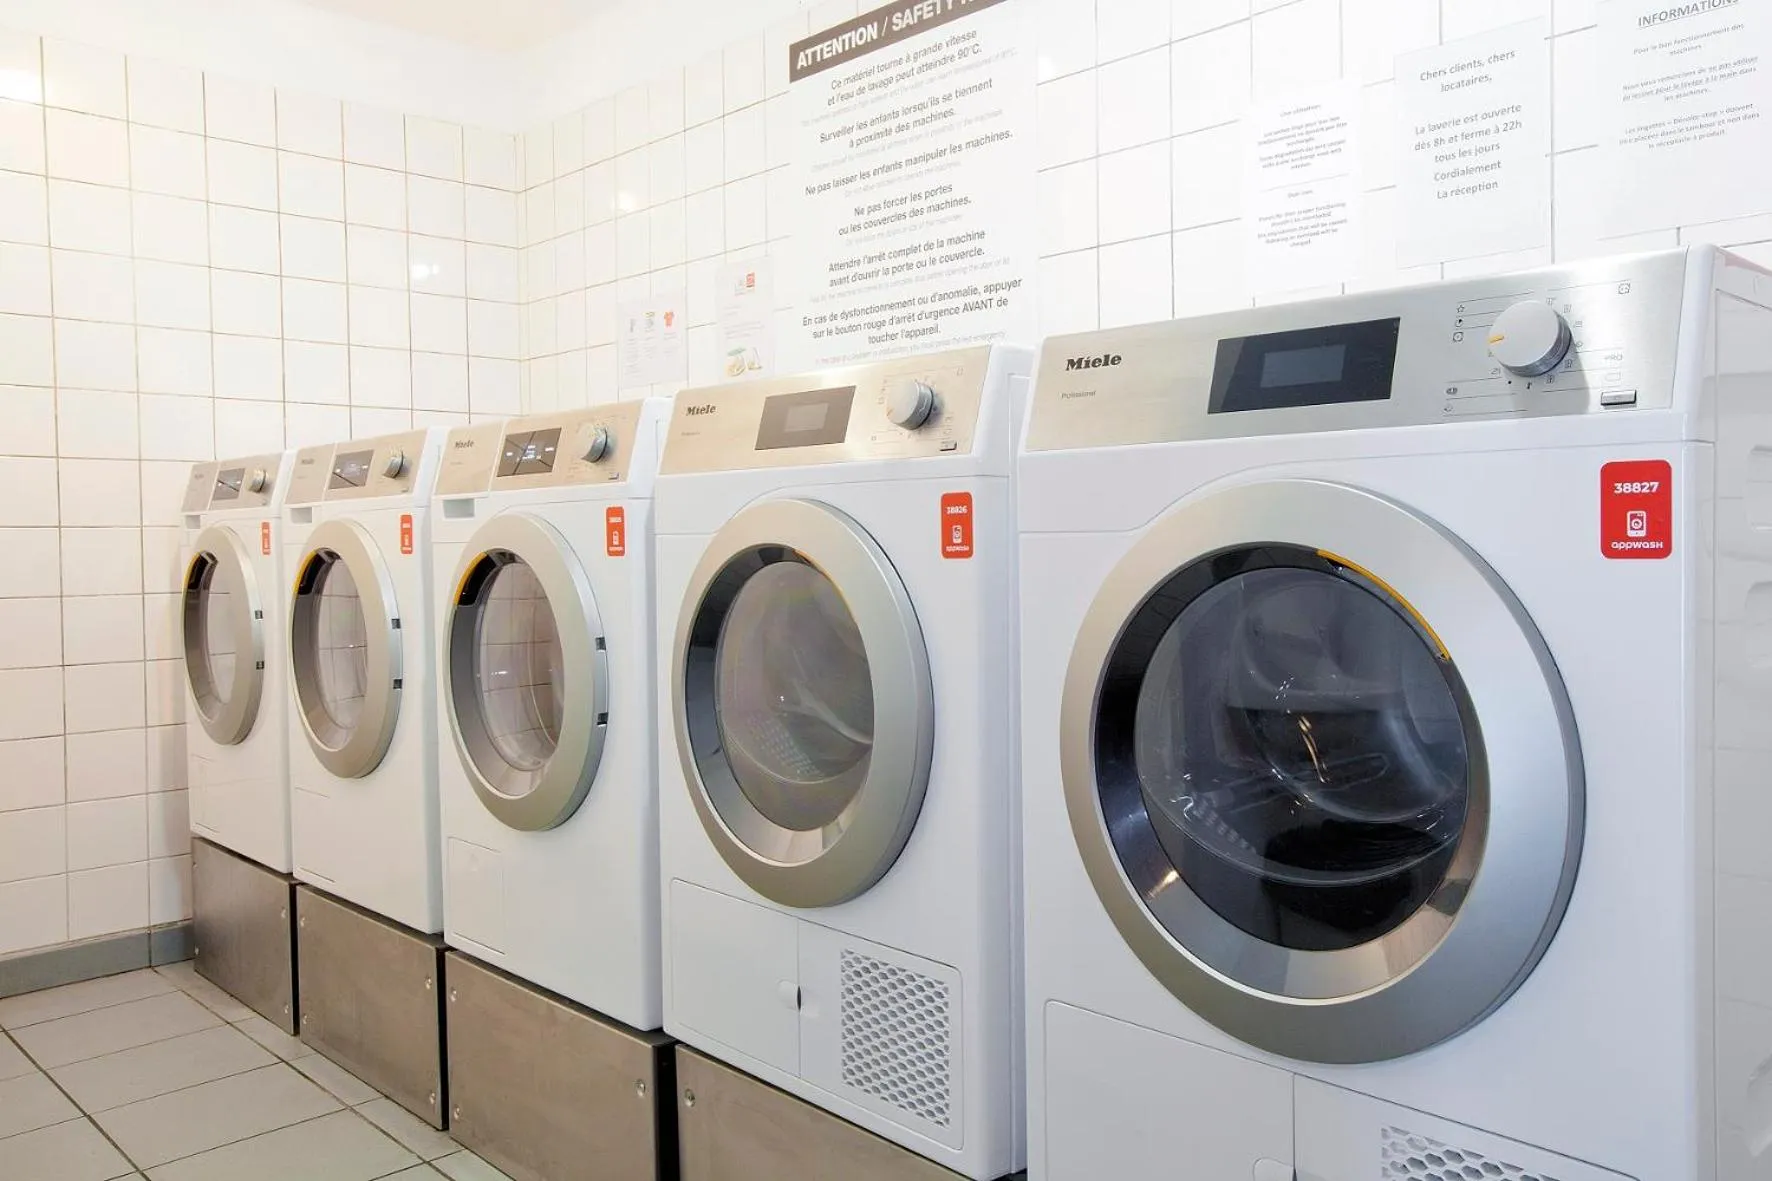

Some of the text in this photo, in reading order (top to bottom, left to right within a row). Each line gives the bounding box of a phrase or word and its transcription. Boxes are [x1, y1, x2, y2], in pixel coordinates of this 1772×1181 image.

[1638, 0, 1739, 28] INFORMATION
[796, 0, 957, 71] ATTENTION / SAFETY
[1420, 51, 1515, 80] Chers clients, chers
[1440, 74, 1492, 92] locataires,
[819, 125, 854, 143] Surveiller
[856, 121, 868, 130] les
[870, 110, 900, 126] enfants
[901, 96, 940, 116] lorsqu'ils
[941, 93, 952, 103] se
[954, 78, 993, 98] tiennent
[1415, 105, 1522, 136] La laverie est ouverte
[1414, 120, 1522, 150] dès 8h et ferme à 22h
[805, 187, 815, 195] Ne
[817, 183, 831, 194] pas
[832, 175, 858, 187] laisser
[860, 171, 871, 180] les
[872, 161, 902, 176] enfants
[904, 148, 948, 166] manipuler
[949, 144, 962, 154] les
[965, 131, 1013, 149] machines.
[1434, 143, 1500, 162] tous les jours
[1433, 160, 1501, 181] Cordialement
[854, 185, 953, 216] Ne pas forcer les portes
[1437, 181, 1498, 199] La réception
[838, 197, 972, 235] ou les couvercles des machines.
[828, 231, 986, 272] Attendre l'arrêt complet de la machine
[829, 247, 985, 287] avant d'ouvrir la porte ou le couvercle.
[802, 280, 1023, 326] En cas de dysfonctionnement ou d'anomalie, appuyer
[812, 297, 1009, 339] sur le bouton rouge d'arrêt d'urgence AVANT de
[867, 324, 941, 344] toucher l'appareil.
[1065, 354, 1122, 371] Miele
[686, 404, 717, 416] Miele
[1613, 482, 1660, 494] 38827
